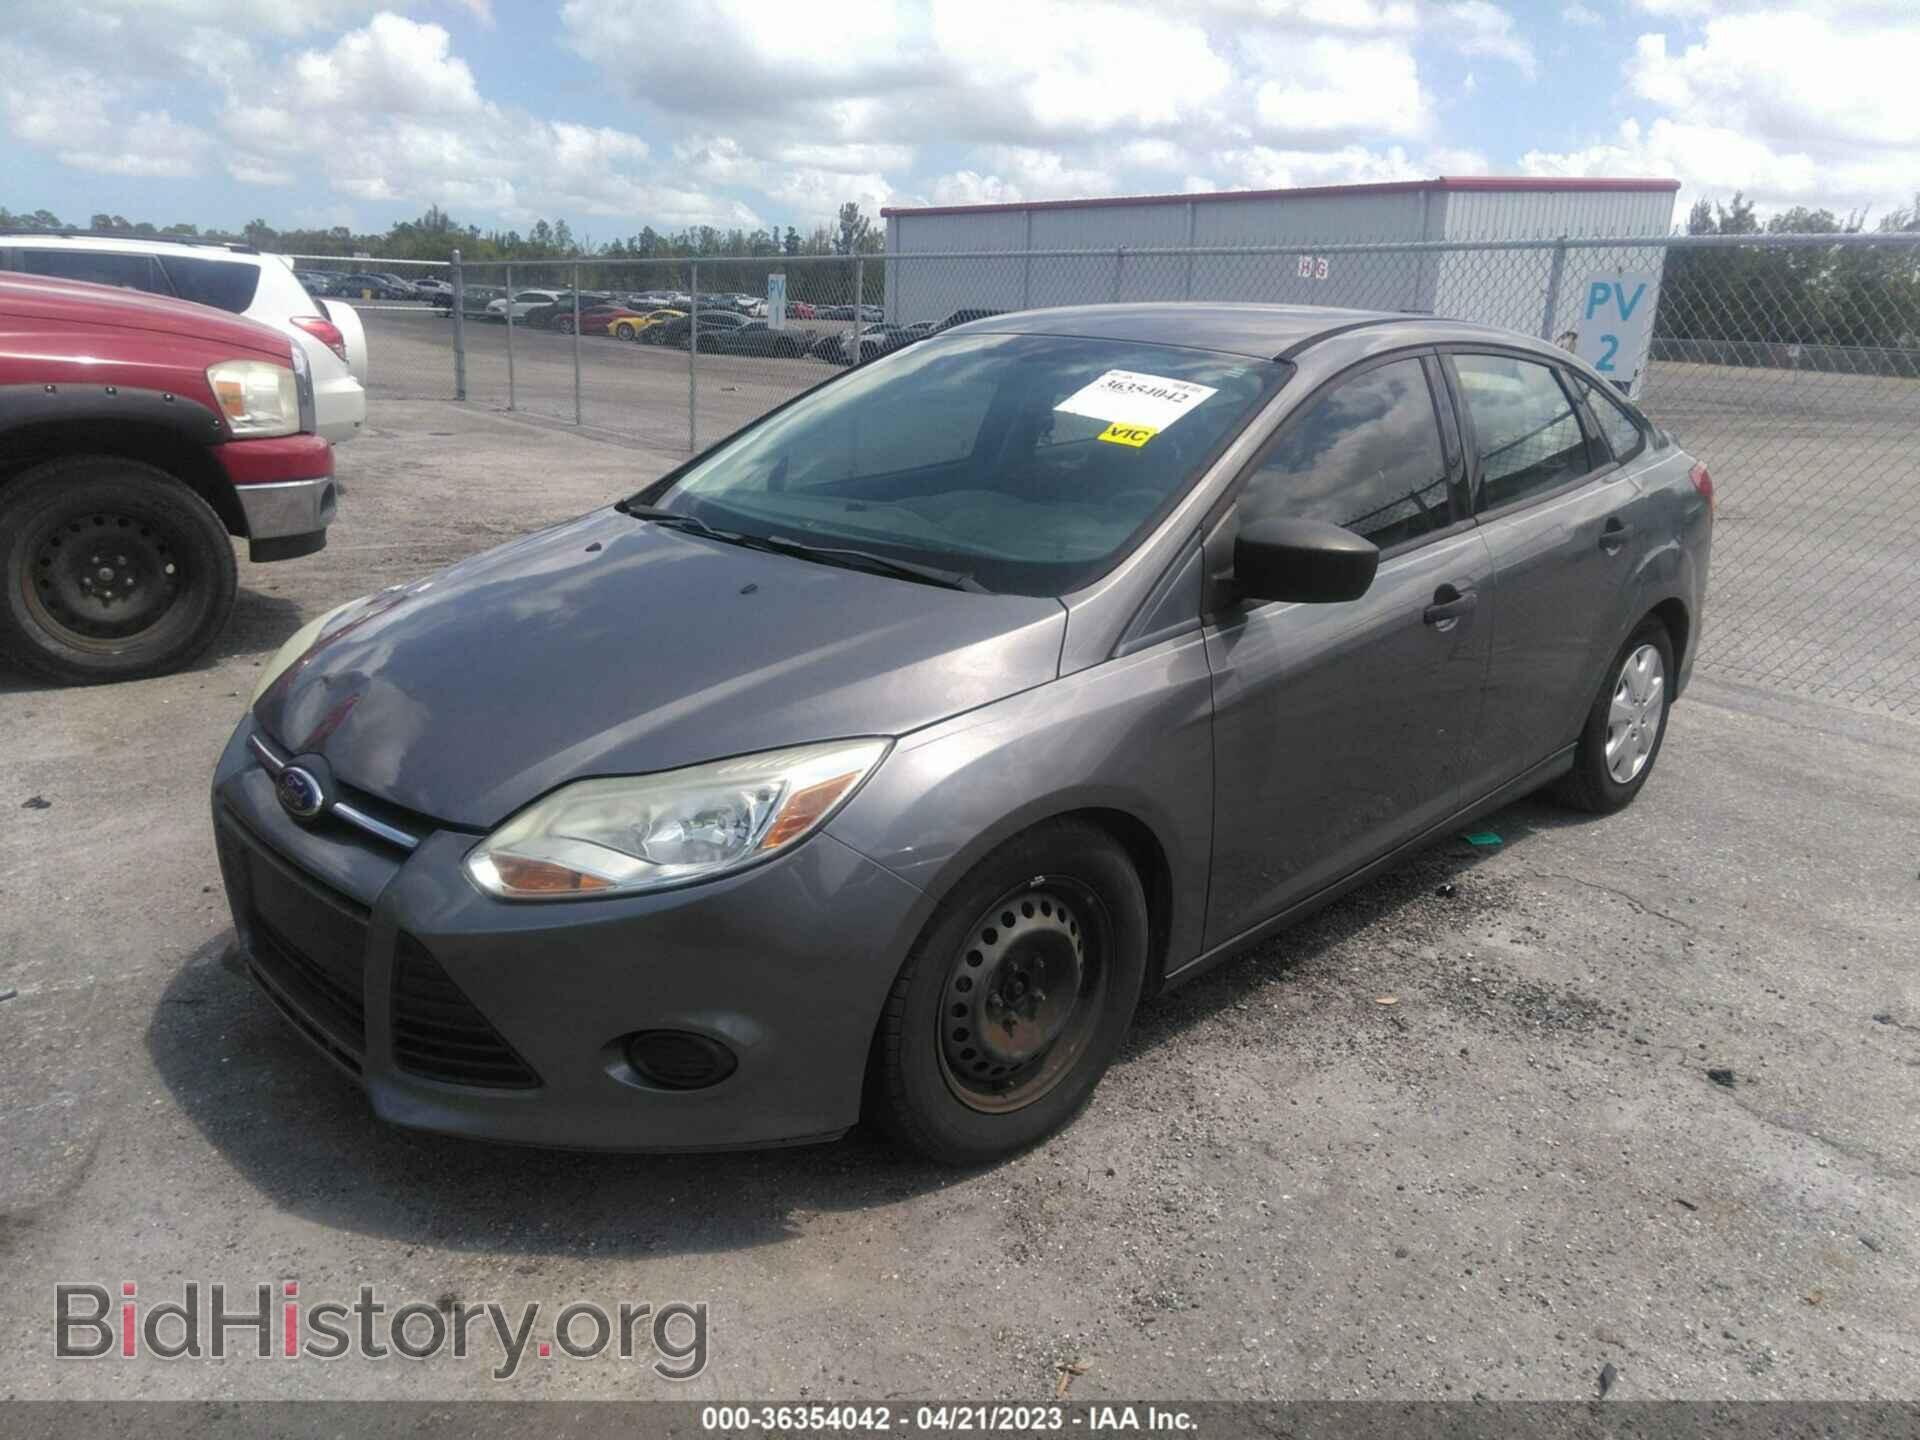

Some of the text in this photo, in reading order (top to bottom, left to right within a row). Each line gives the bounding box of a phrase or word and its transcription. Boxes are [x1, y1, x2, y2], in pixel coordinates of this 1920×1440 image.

[1585, 282, 1648, 321] PV
[1595, 334, 1619, 371] 2
[1111, 426, 1149, 441] VIC
